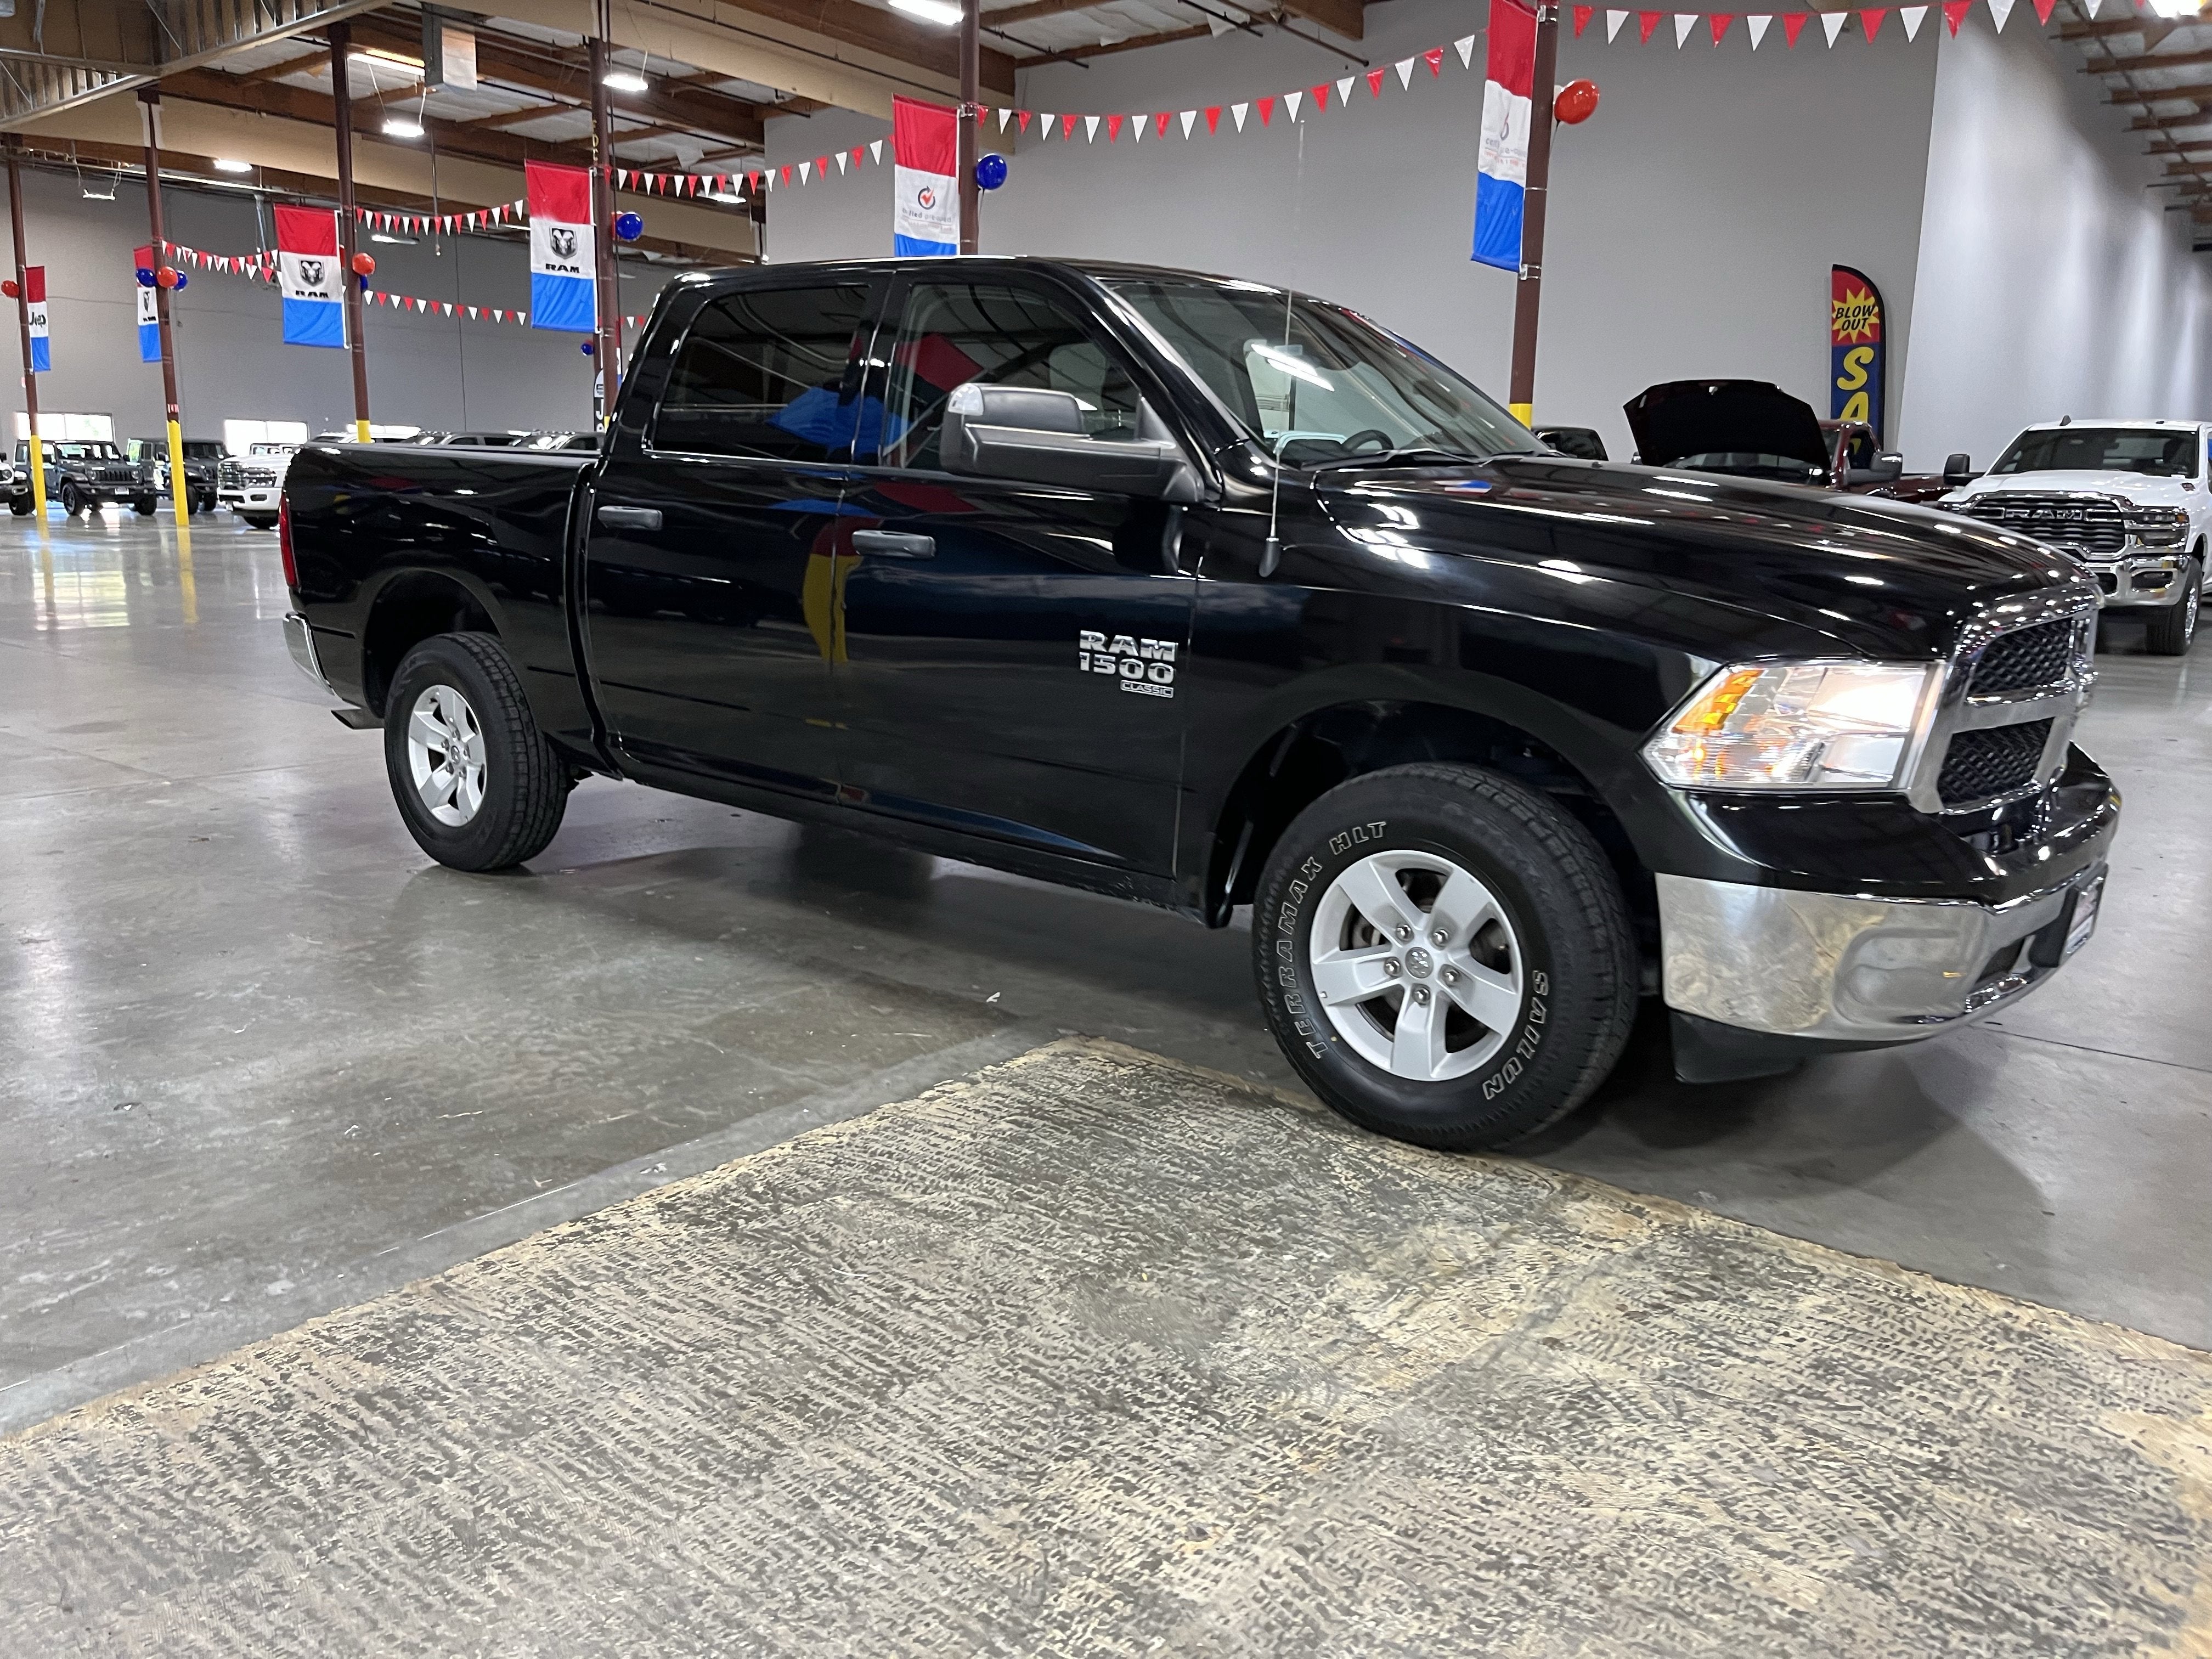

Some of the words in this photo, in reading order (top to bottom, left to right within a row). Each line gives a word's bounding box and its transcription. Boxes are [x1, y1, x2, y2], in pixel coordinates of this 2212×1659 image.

[545, 263, 580, 274] RAM
[1836, 305, 1874, 319] BLOW
[1842, 318, 1869, 331] OUT
[2005, 508, 2083, 520] RAM
[1079, 630, 1178, 662] RAM
[1079, 651, 1176, 684] 1500
[1122, 681, 1173, 697] CLASSIC
[1277, 856, 1329, 1059] TERRAMAX
[1329, 821, 1387, 855] HLT
[1482, 970, 1549, 1100] SAILUN
